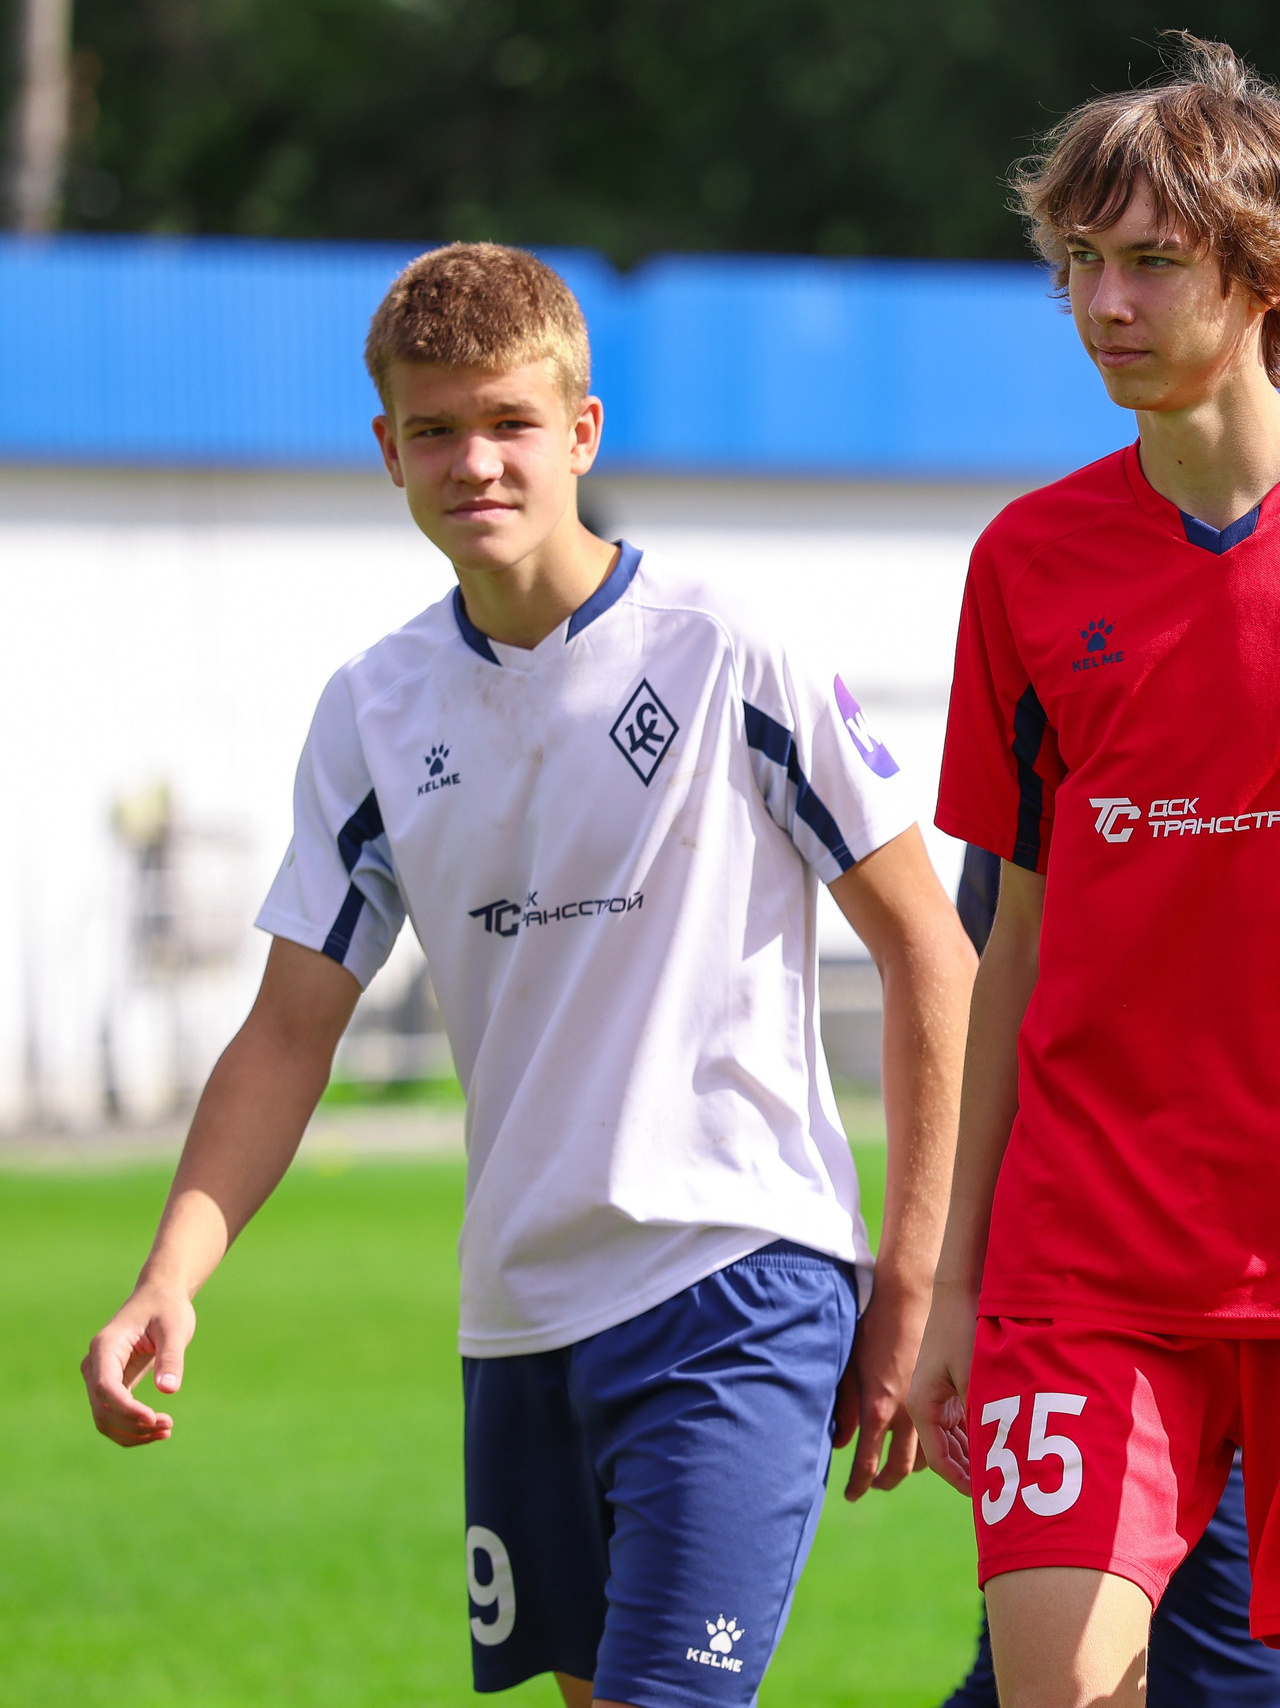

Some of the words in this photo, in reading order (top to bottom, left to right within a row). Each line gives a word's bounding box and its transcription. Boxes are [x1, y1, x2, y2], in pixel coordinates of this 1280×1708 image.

[1072, 651, 1125, 673] KELME
[417, 773, 462, 797] KELME
[1148, 796, 1200, 818] ДСК
[980, 1392, 1088, 1526] 35
[466, 1524, 517, 1647] 9
[686, 1647, 745, 1673] KELME
